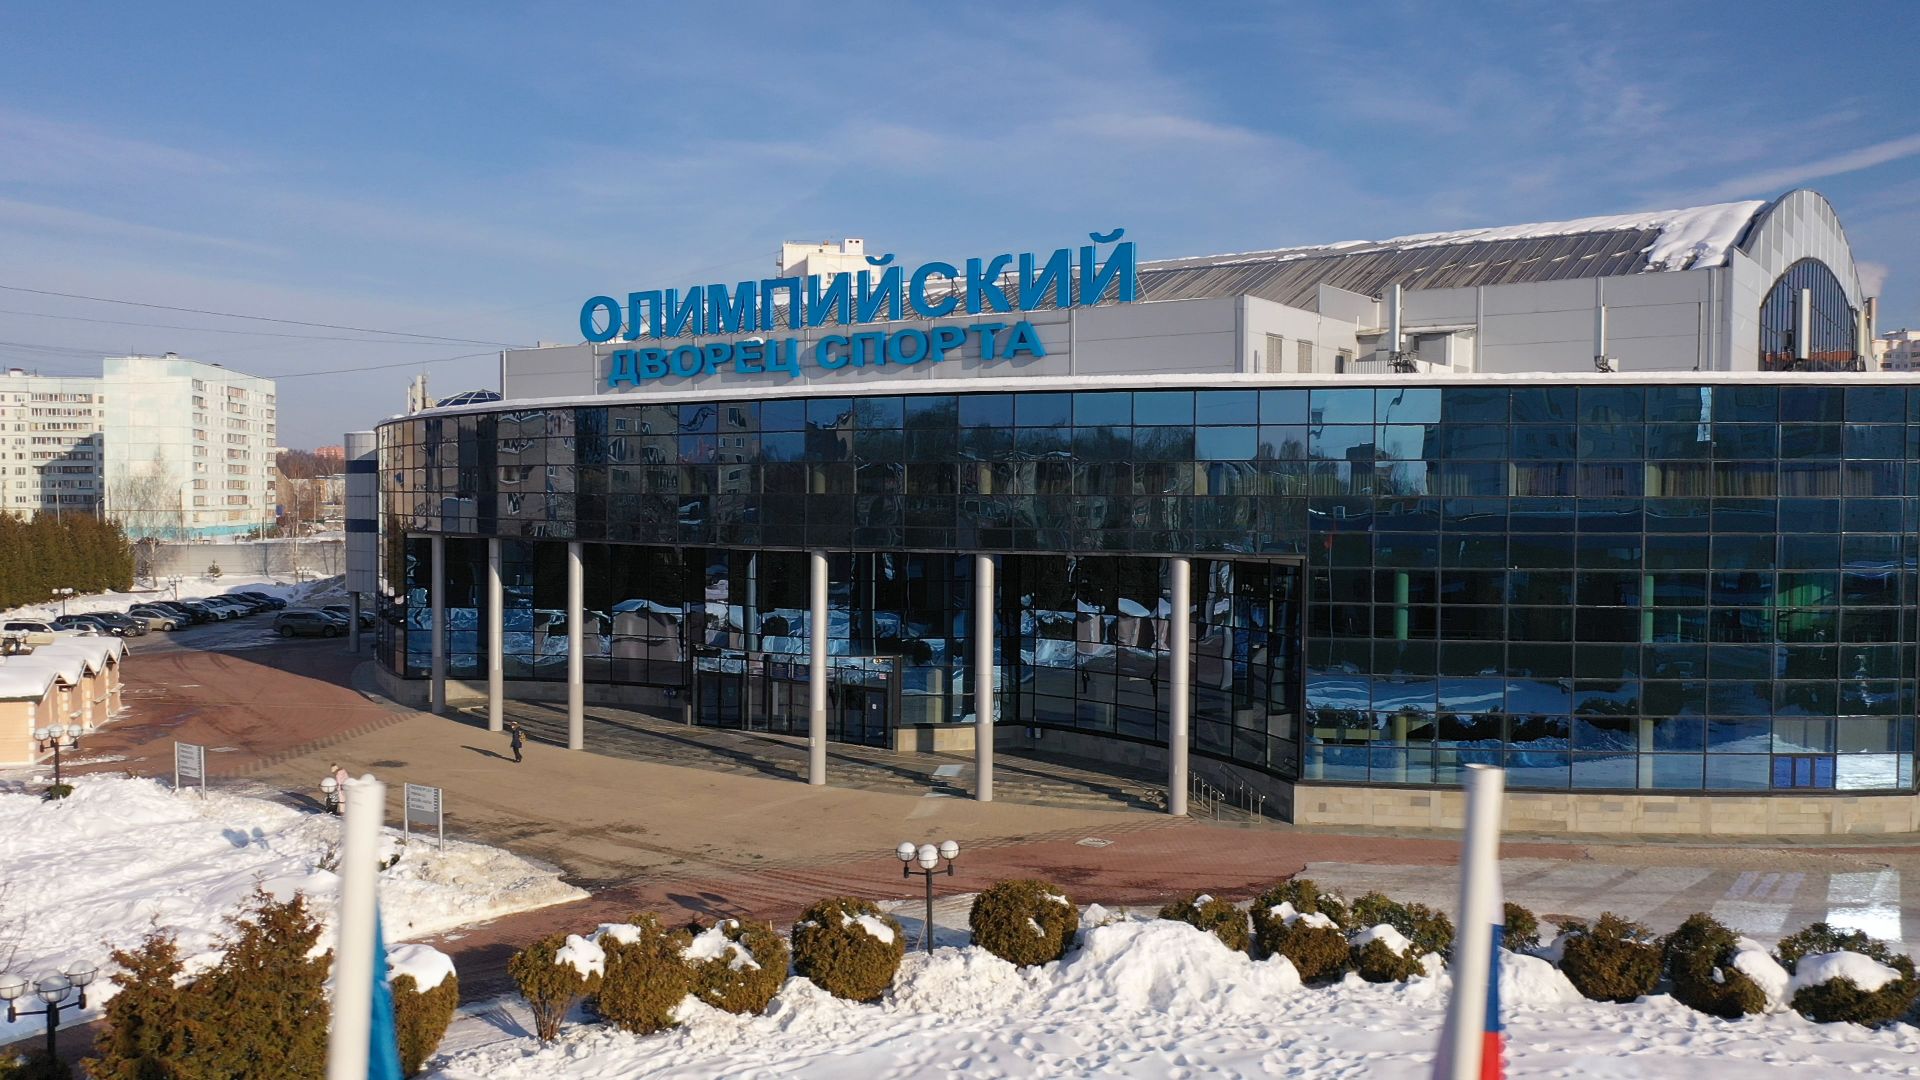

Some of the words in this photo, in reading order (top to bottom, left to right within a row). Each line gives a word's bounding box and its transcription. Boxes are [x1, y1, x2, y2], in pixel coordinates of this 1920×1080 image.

[580, 228, 1136, 343] ОЛИМПИЙСКИЙ
[608, 338, 801, 387] ДВОРЕЦ
[815, 321, 1046, 369] СПОРТА
